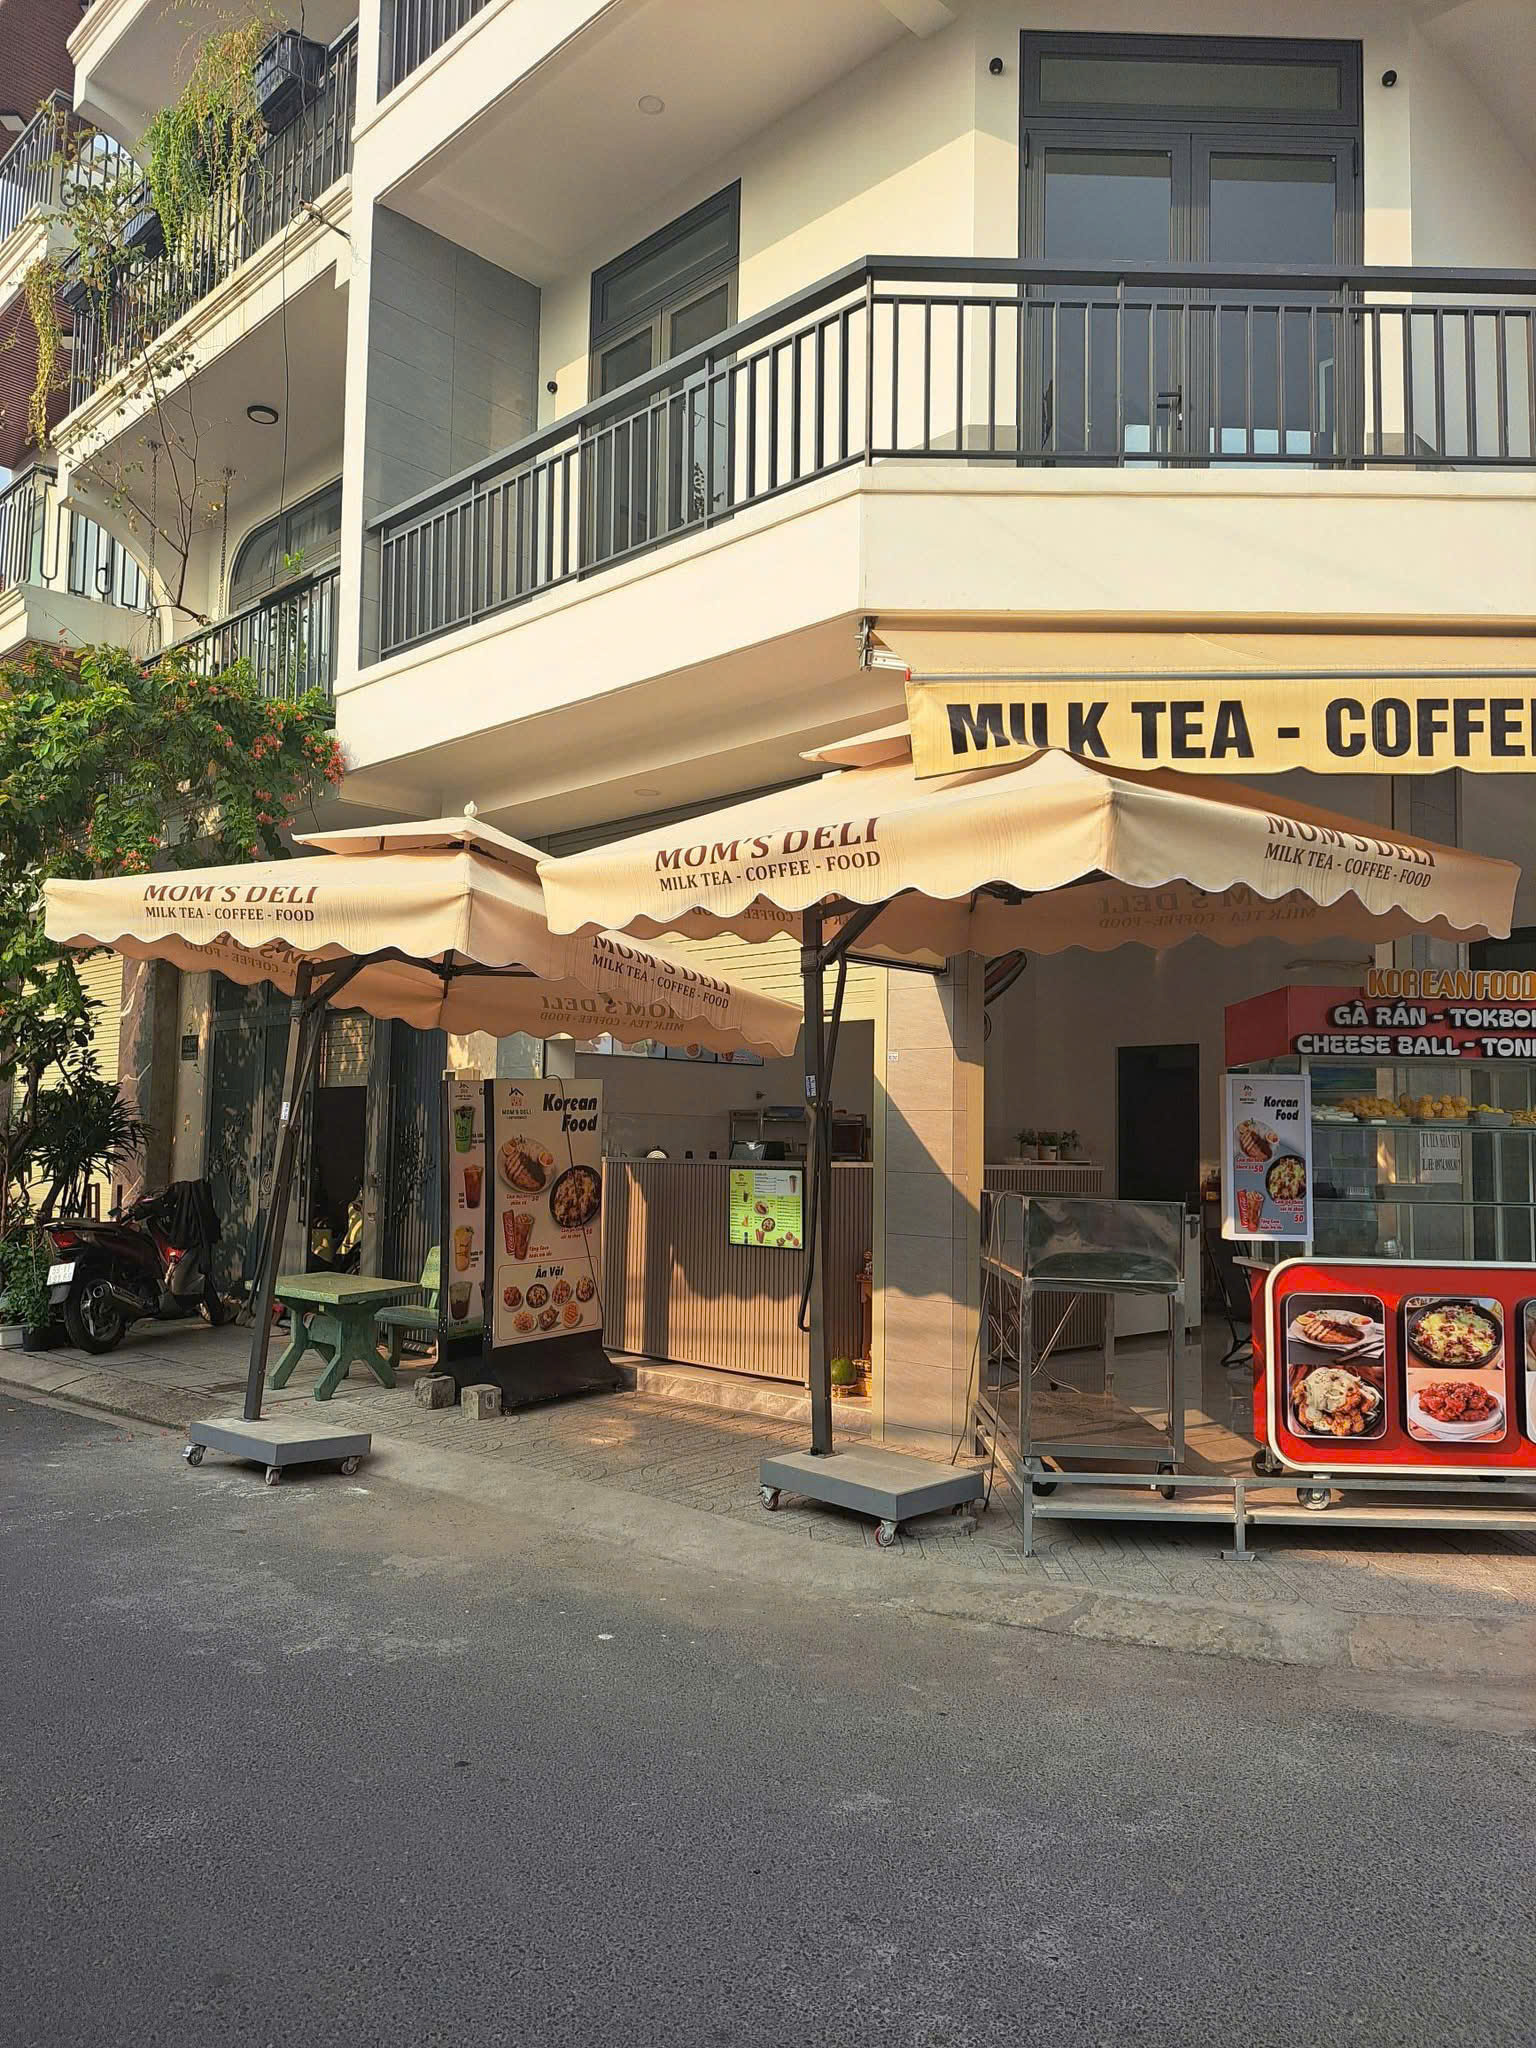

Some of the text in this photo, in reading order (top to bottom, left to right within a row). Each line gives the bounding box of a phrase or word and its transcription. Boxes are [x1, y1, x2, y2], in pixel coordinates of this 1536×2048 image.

[946, 697, 1536, 758] MILK TEA - COFFE
[655, 816, 880, 872] MOM'S DELI
[1373, 839, 1436, 867] DELI
[659, 874, 698, 892] MILK
[700, 870, 733, 887] TEA
[745, 859, 811, 881] COFFEE
[826, 850, 881, 871] FOOD
[1264, 843, 1307, 864] MILK
[1307, 850, 1333, 870] TEA
[1344, 857, 1393, 881] COFFEE
[1400, 868, 1432, 888] FOOD
[143, 885, 320, 904] MOM'S DELI
[145, 906, 177, 918] MILK
[178, 907, 204, 919] TEA
[214, 907, 264, 920] COFFEE
[276, 908, 315, 922] FOOD
[592, 954, 623, 974] MILK
[626, 964, 648, 982] TEA
[657, 976, 696, 998] COFFEE
[702, 992, 729, 1009] FOOD
[680, 966, 732, 995] DELI
[1368, 968, 1536, 1000] KOREAN FOOD
[1334, 1000, 1369, 1025] GÀ
[1376, 1001, 1427, 1026] RÁN
[1450, 1008, 1536, 1028] TOKBO
[1297, 1034, 1391, 1054] CHEESE
[1398, 1036, 1461, 1056] BALL
[1481, 1037, 1536, 1057] TON
[543, 1093, 597, 1111] Korean
[1263, 1096, 1299, 1107] Korean
[1275, 1109, 1299, 1120] Food
[561, 1113, 598, 1132] Food
[535, 1265, 548, 1279] Ăn
